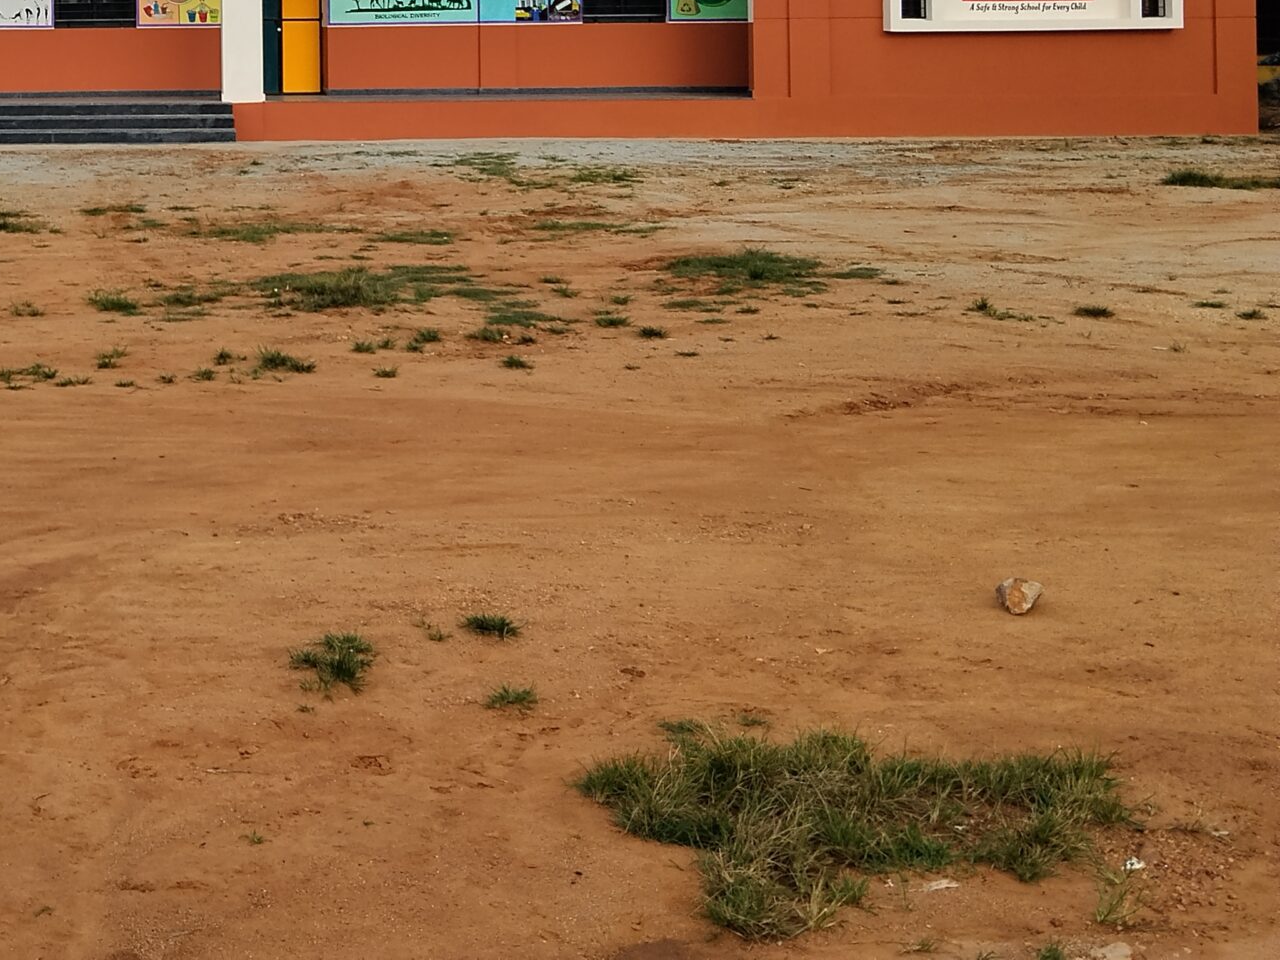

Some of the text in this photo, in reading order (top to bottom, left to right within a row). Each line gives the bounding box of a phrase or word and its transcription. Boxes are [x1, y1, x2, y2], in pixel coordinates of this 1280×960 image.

[976, 3, 990, 12] Safe
[998, 3, 1019, 14] Strong
[1020, 2, 1041, 11] School
[1042, 2, 1051, 12] for
[1053, 2, 1070, 12] Every
[1070, 2, 1086, 10] Child
